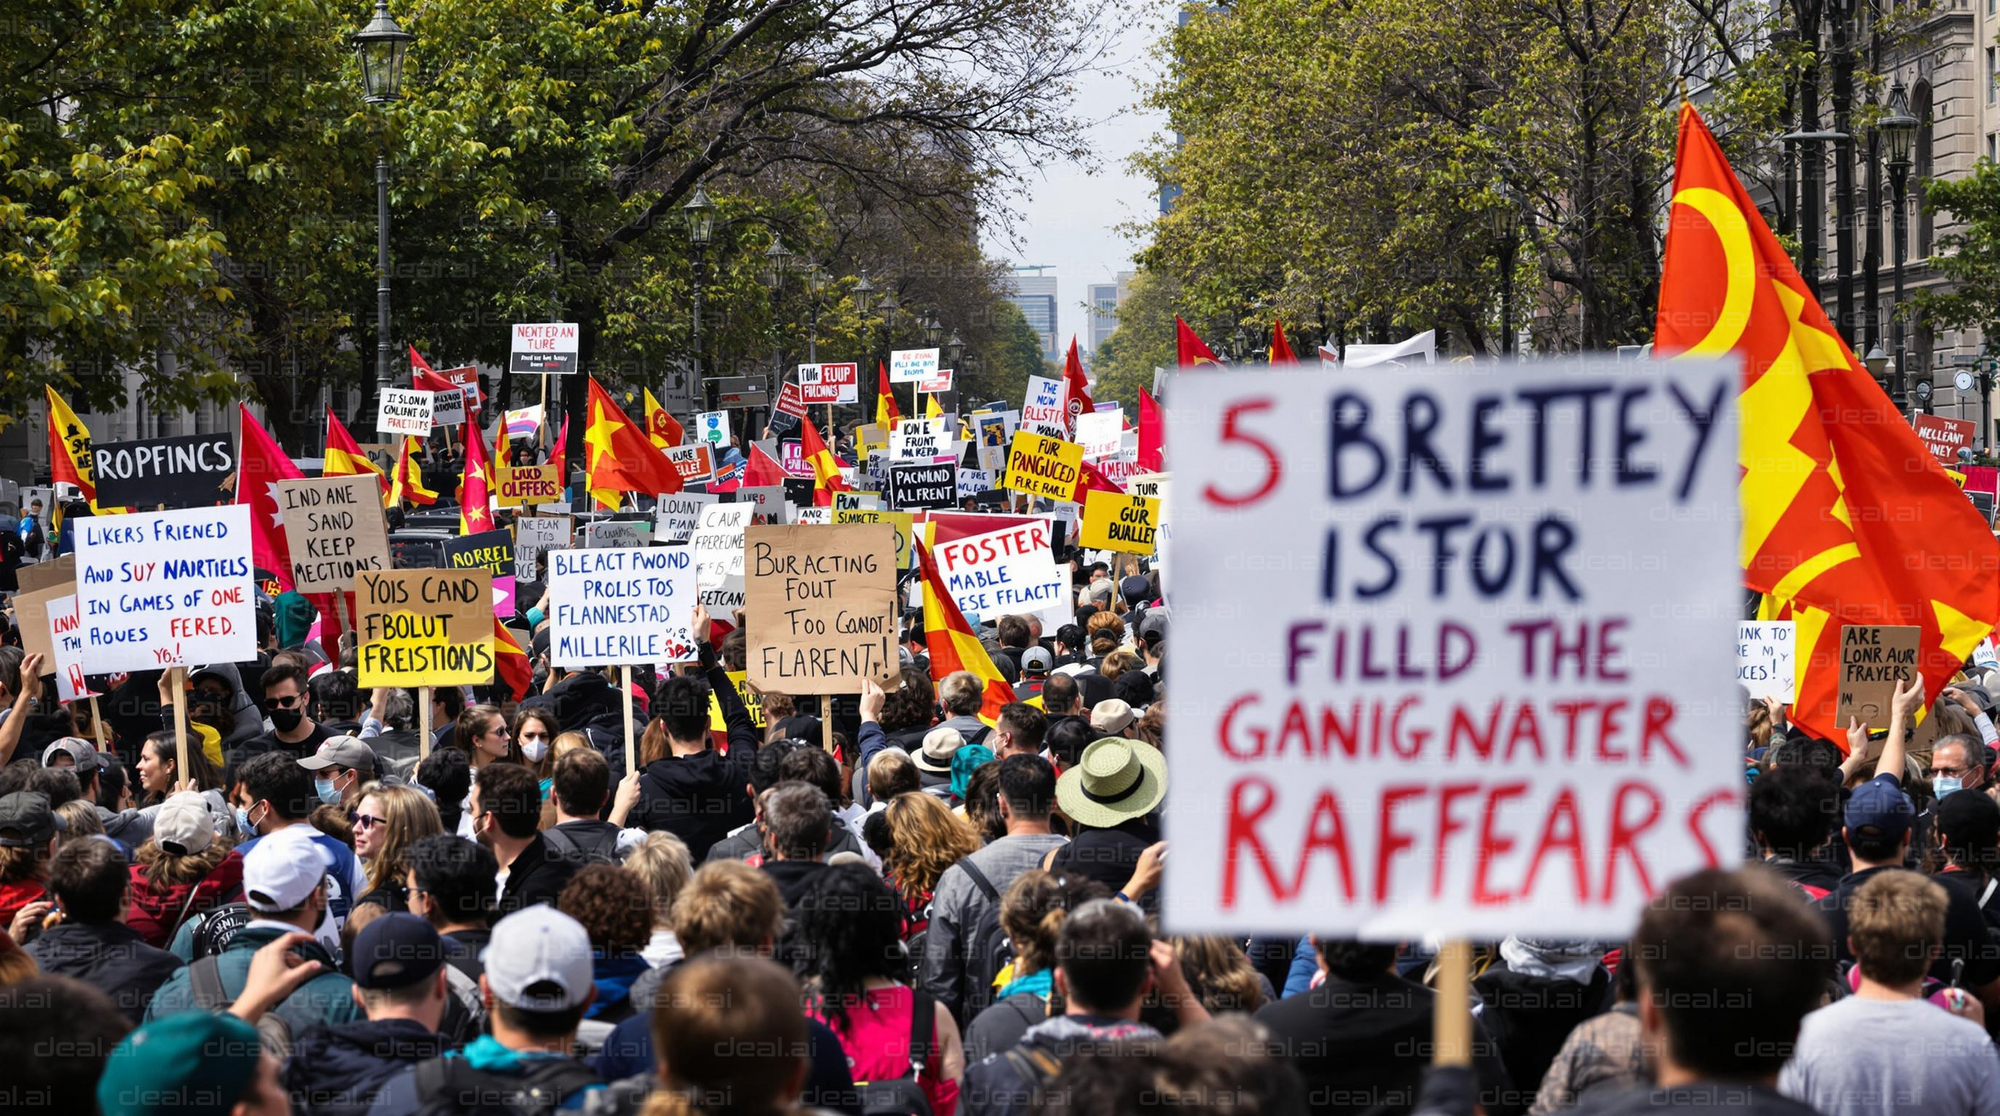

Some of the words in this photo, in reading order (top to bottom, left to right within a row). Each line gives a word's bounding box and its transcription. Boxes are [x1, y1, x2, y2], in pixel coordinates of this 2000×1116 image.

[1201, 396, 1282, 510] 5
[1326, 379, 1730, 506] BRETTEY
[95, 441, 233, 480] ROPFINCS
[87, 526, 144, 546] LIKERS
[153, 519, 228, 541] FRIENED
[308, 512, 354, 532] SAND
[306, 537, 355, 558] KEEP
[943, 528, 1050, 571] FOSTER
[84, 565, 113, 584] AND
[121, 562, 156, 582] SUY
[949, 565, 1012, 592] MABLE
[88, 599, 110, 615] IN
[120, 594, 174, 613] GAMES
[183, 589, 204, 607] OF
[211, 586, 245, 606] ONE
[421, 576, 479, 603] CAND
[785, 578, 837, 601] FOUT
[364, 613, 454, 640] FBOLUT
[1845, 628, 1881, 646] ARE
[364, 643, 493, 674] FREISTIONS
[559, 634, 661, 658] MILLERILE
[1286, 617, 1479, 687] FILLD
[1507, 616, 1630, 682] THE
[1886, 648, 1915, 665] AUR
[1846, 666, 1910, 682] FRAYERS
[1218, 776, 1739, 913] RAFFEARS
